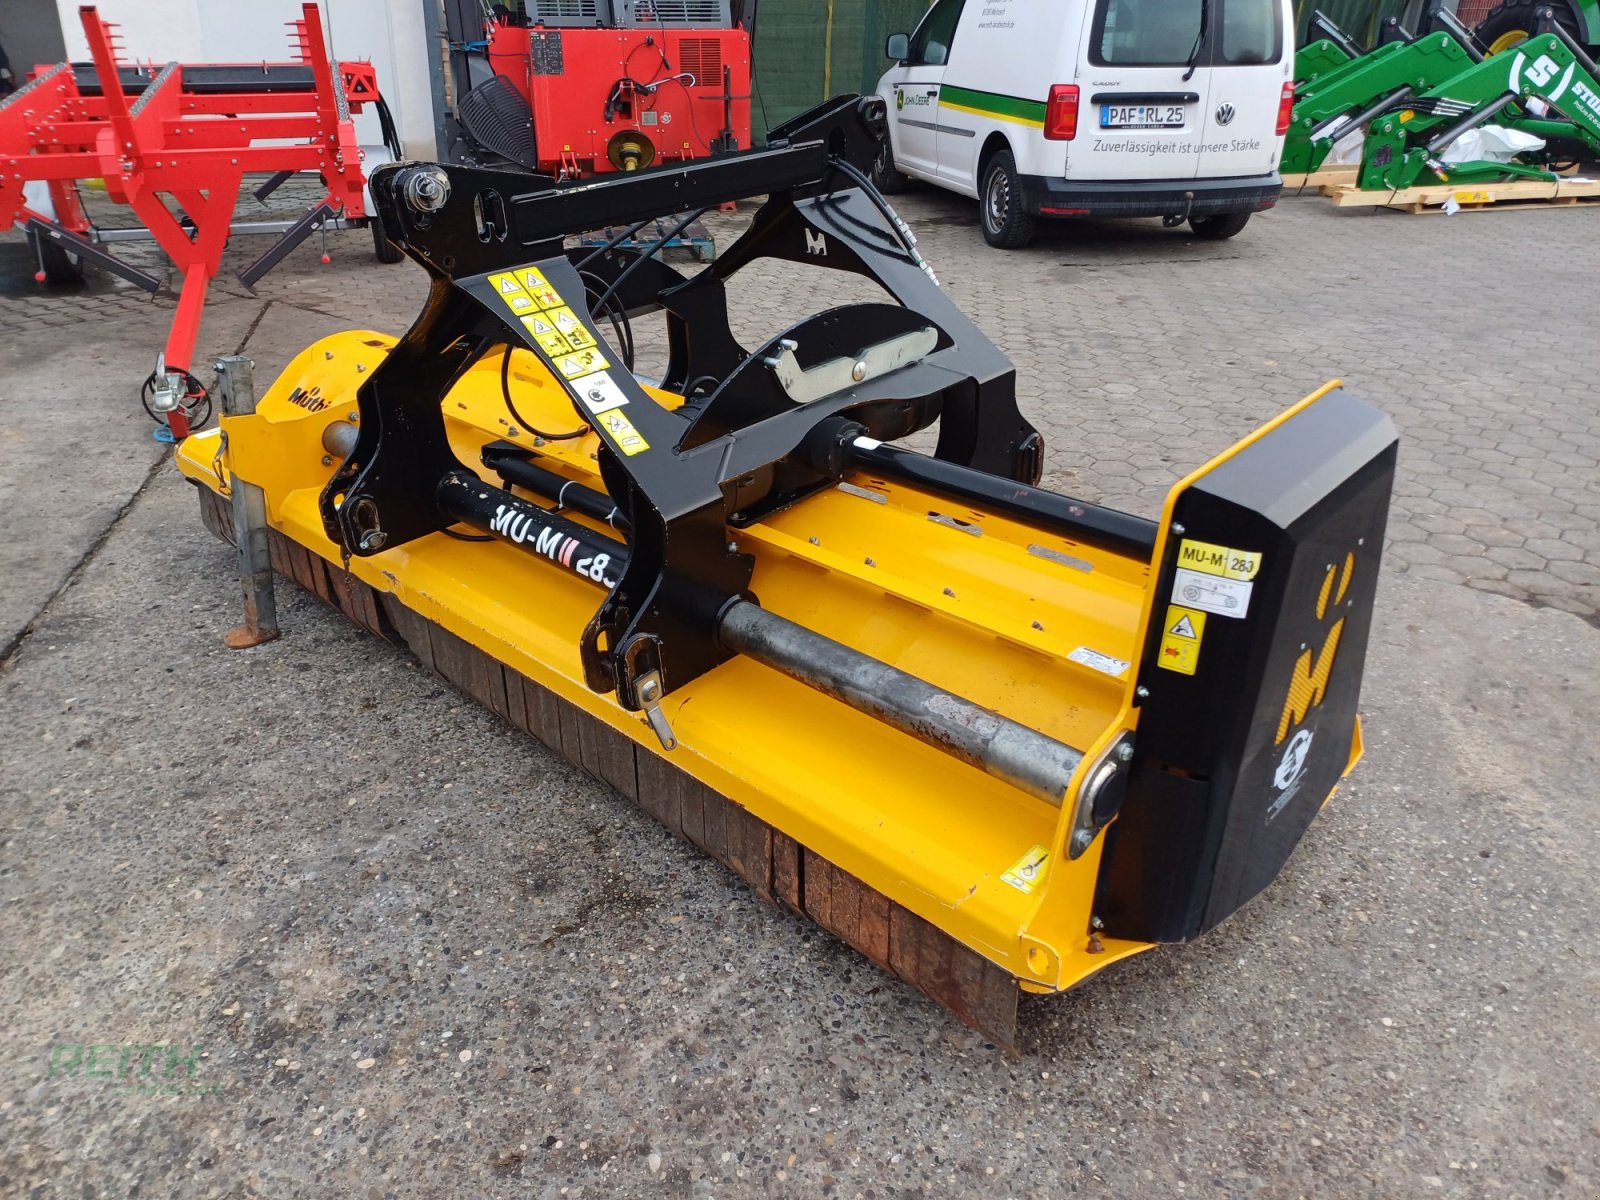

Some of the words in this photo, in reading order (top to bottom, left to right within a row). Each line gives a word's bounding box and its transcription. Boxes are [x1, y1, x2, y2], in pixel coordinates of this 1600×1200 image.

[1110, 107, 1137, 123] PAF
[1146, 107, 1164, 123] RL
[1166, 107, 1184, 123] 25
[1093, 139, 1176, 157] Zuverlässigkeit
[1178, 141, 1191, 154] ist
[1194, 142, 1229, 154] unsere
[1230, 138, 1260, 152] Stärke
[489, 504, 564, 560] MU-M
